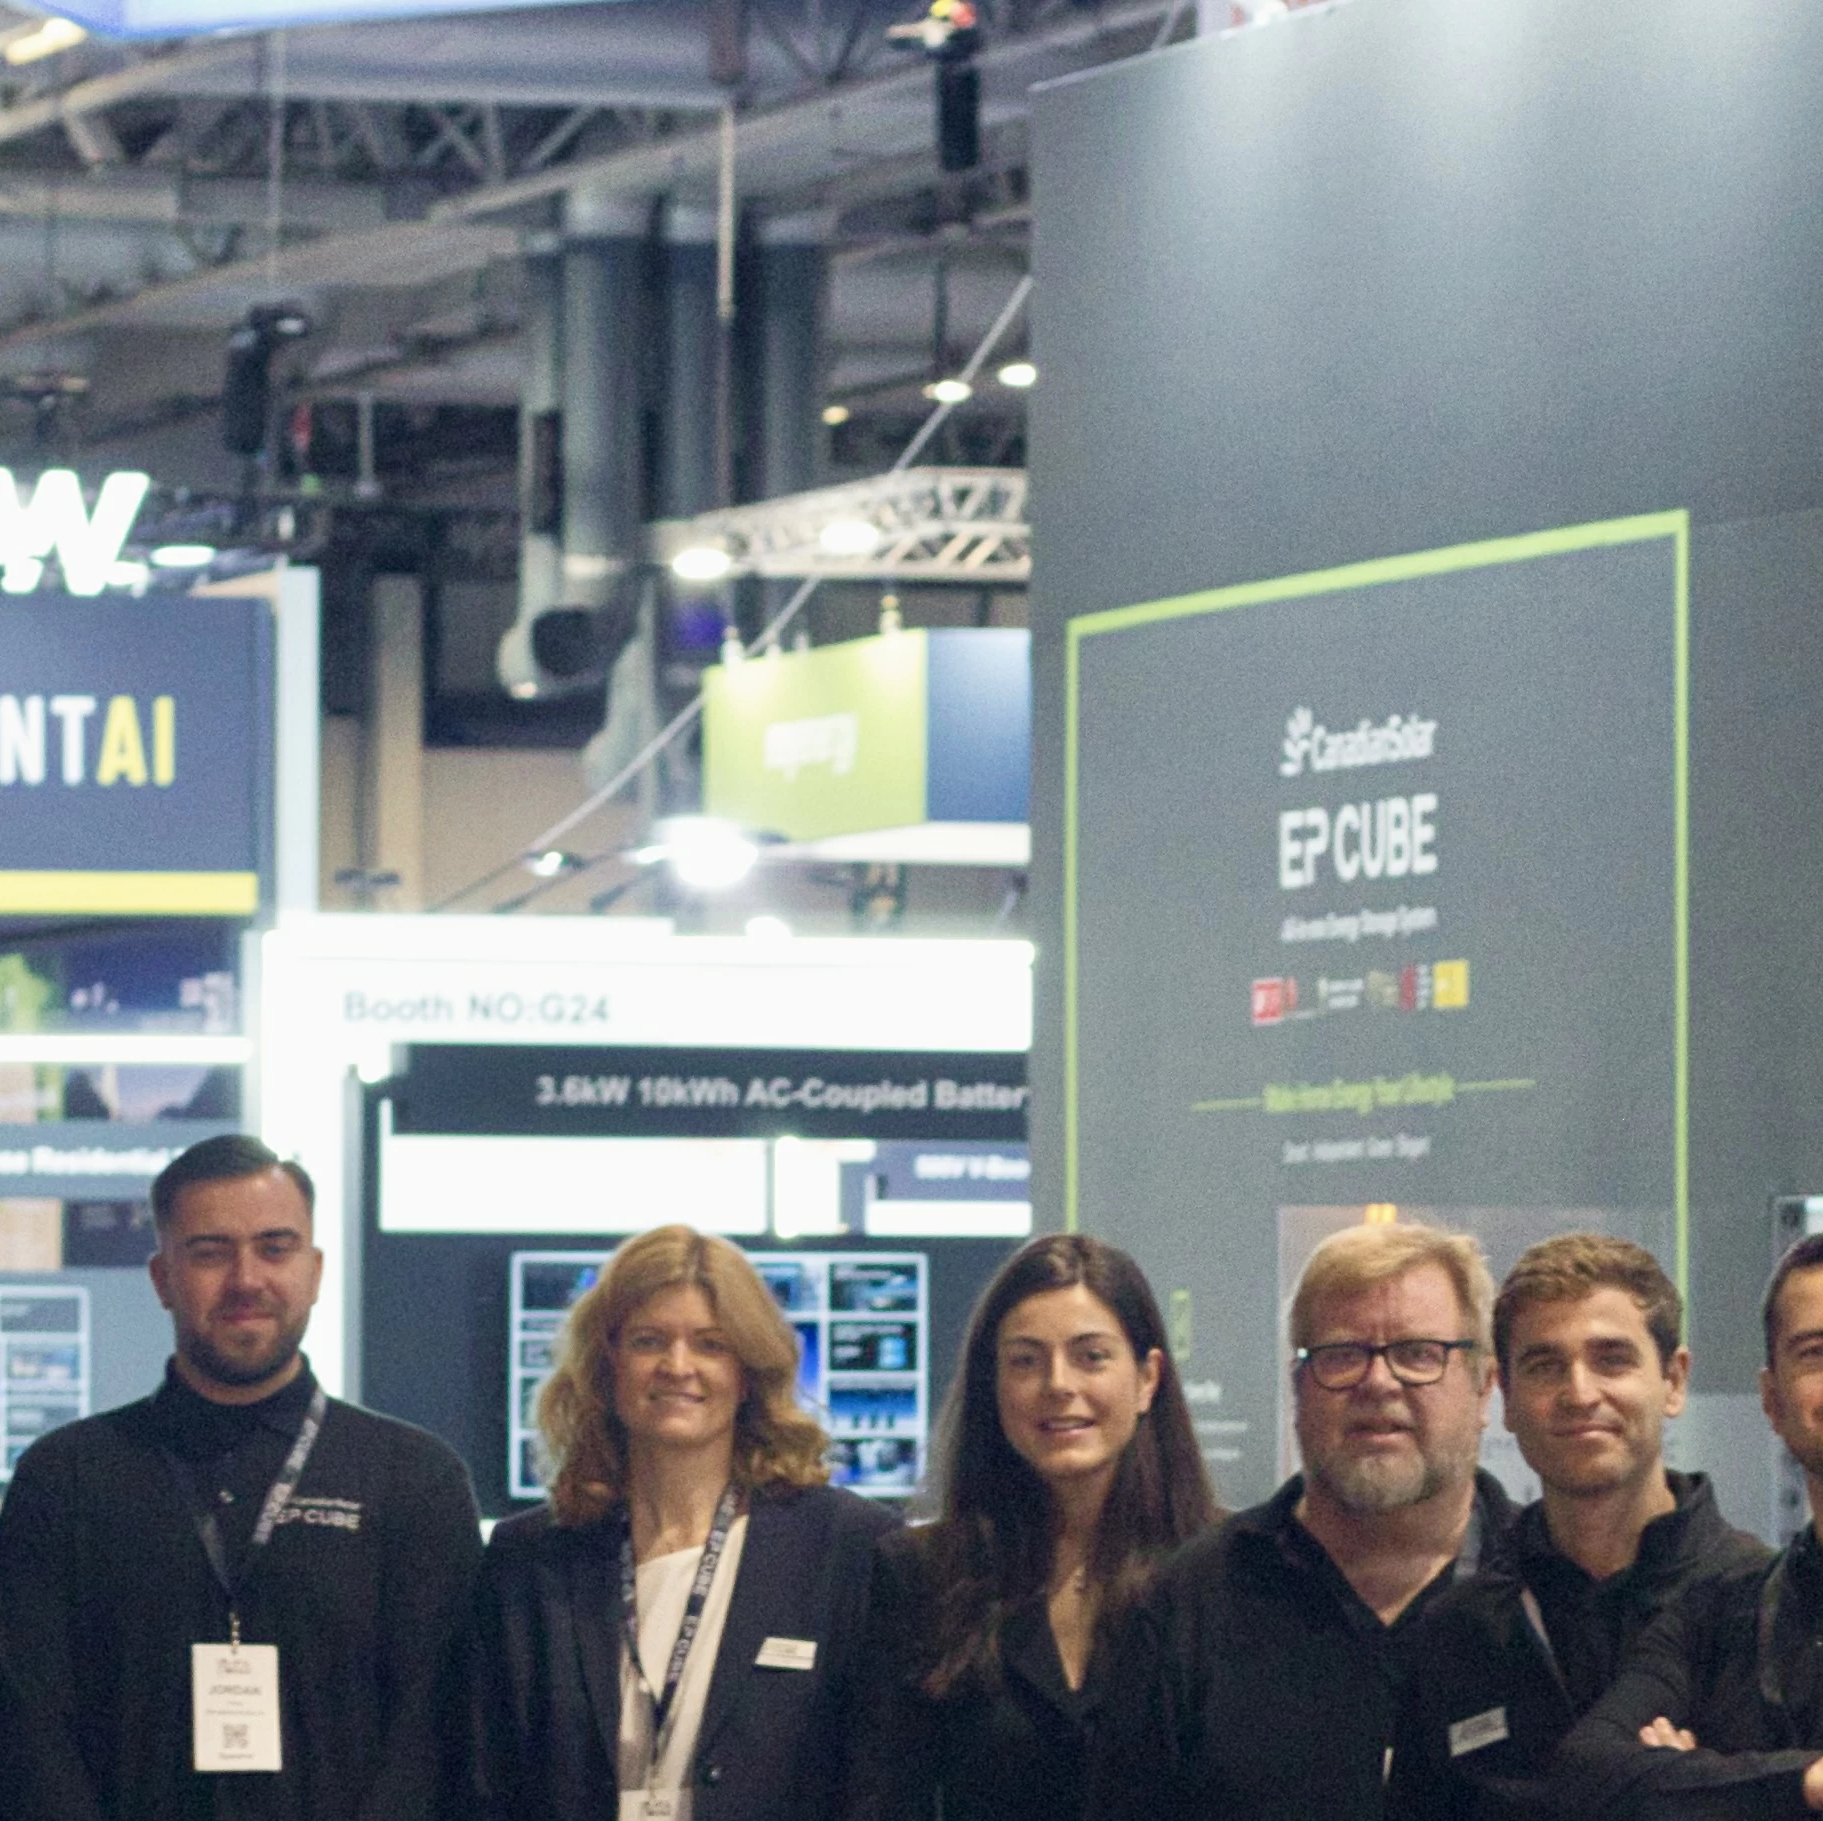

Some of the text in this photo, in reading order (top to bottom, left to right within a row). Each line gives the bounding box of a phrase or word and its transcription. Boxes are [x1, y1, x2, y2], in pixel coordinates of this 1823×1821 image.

[1279, 793, 1438, 890] EP CUBE
[343, 991, 455, 1024] Booth
[745, 1077, 927, 1114] AC-Coupled
